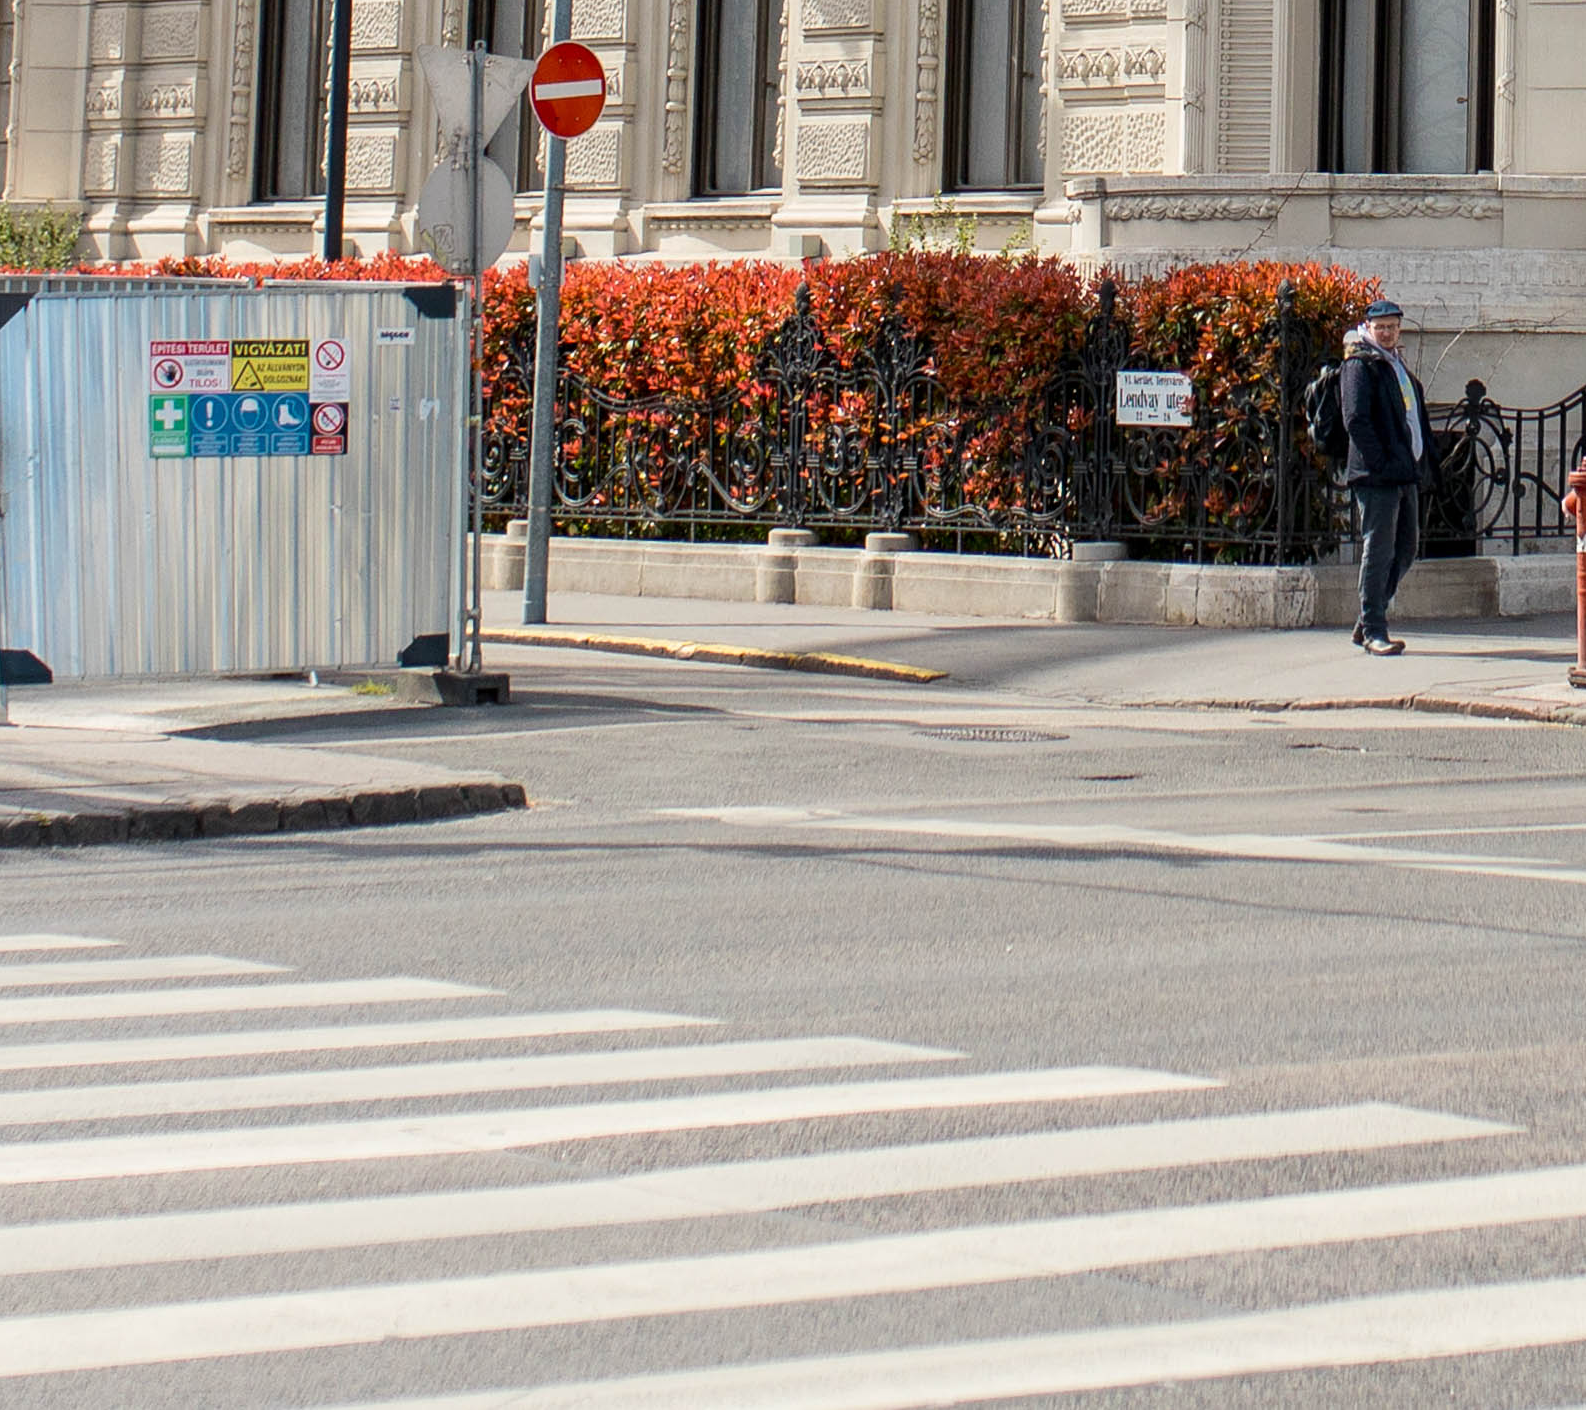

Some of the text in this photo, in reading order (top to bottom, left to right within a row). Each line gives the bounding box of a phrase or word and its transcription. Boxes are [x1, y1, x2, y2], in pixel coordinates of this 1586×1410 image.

[188, 342, 228, 354] TERÜLET
[234, 341, 306, 355] VIGYÁZAT!
[190, 378, 223, 388] TILOS!
[1119, 388, 1159, 412] Lendvay
